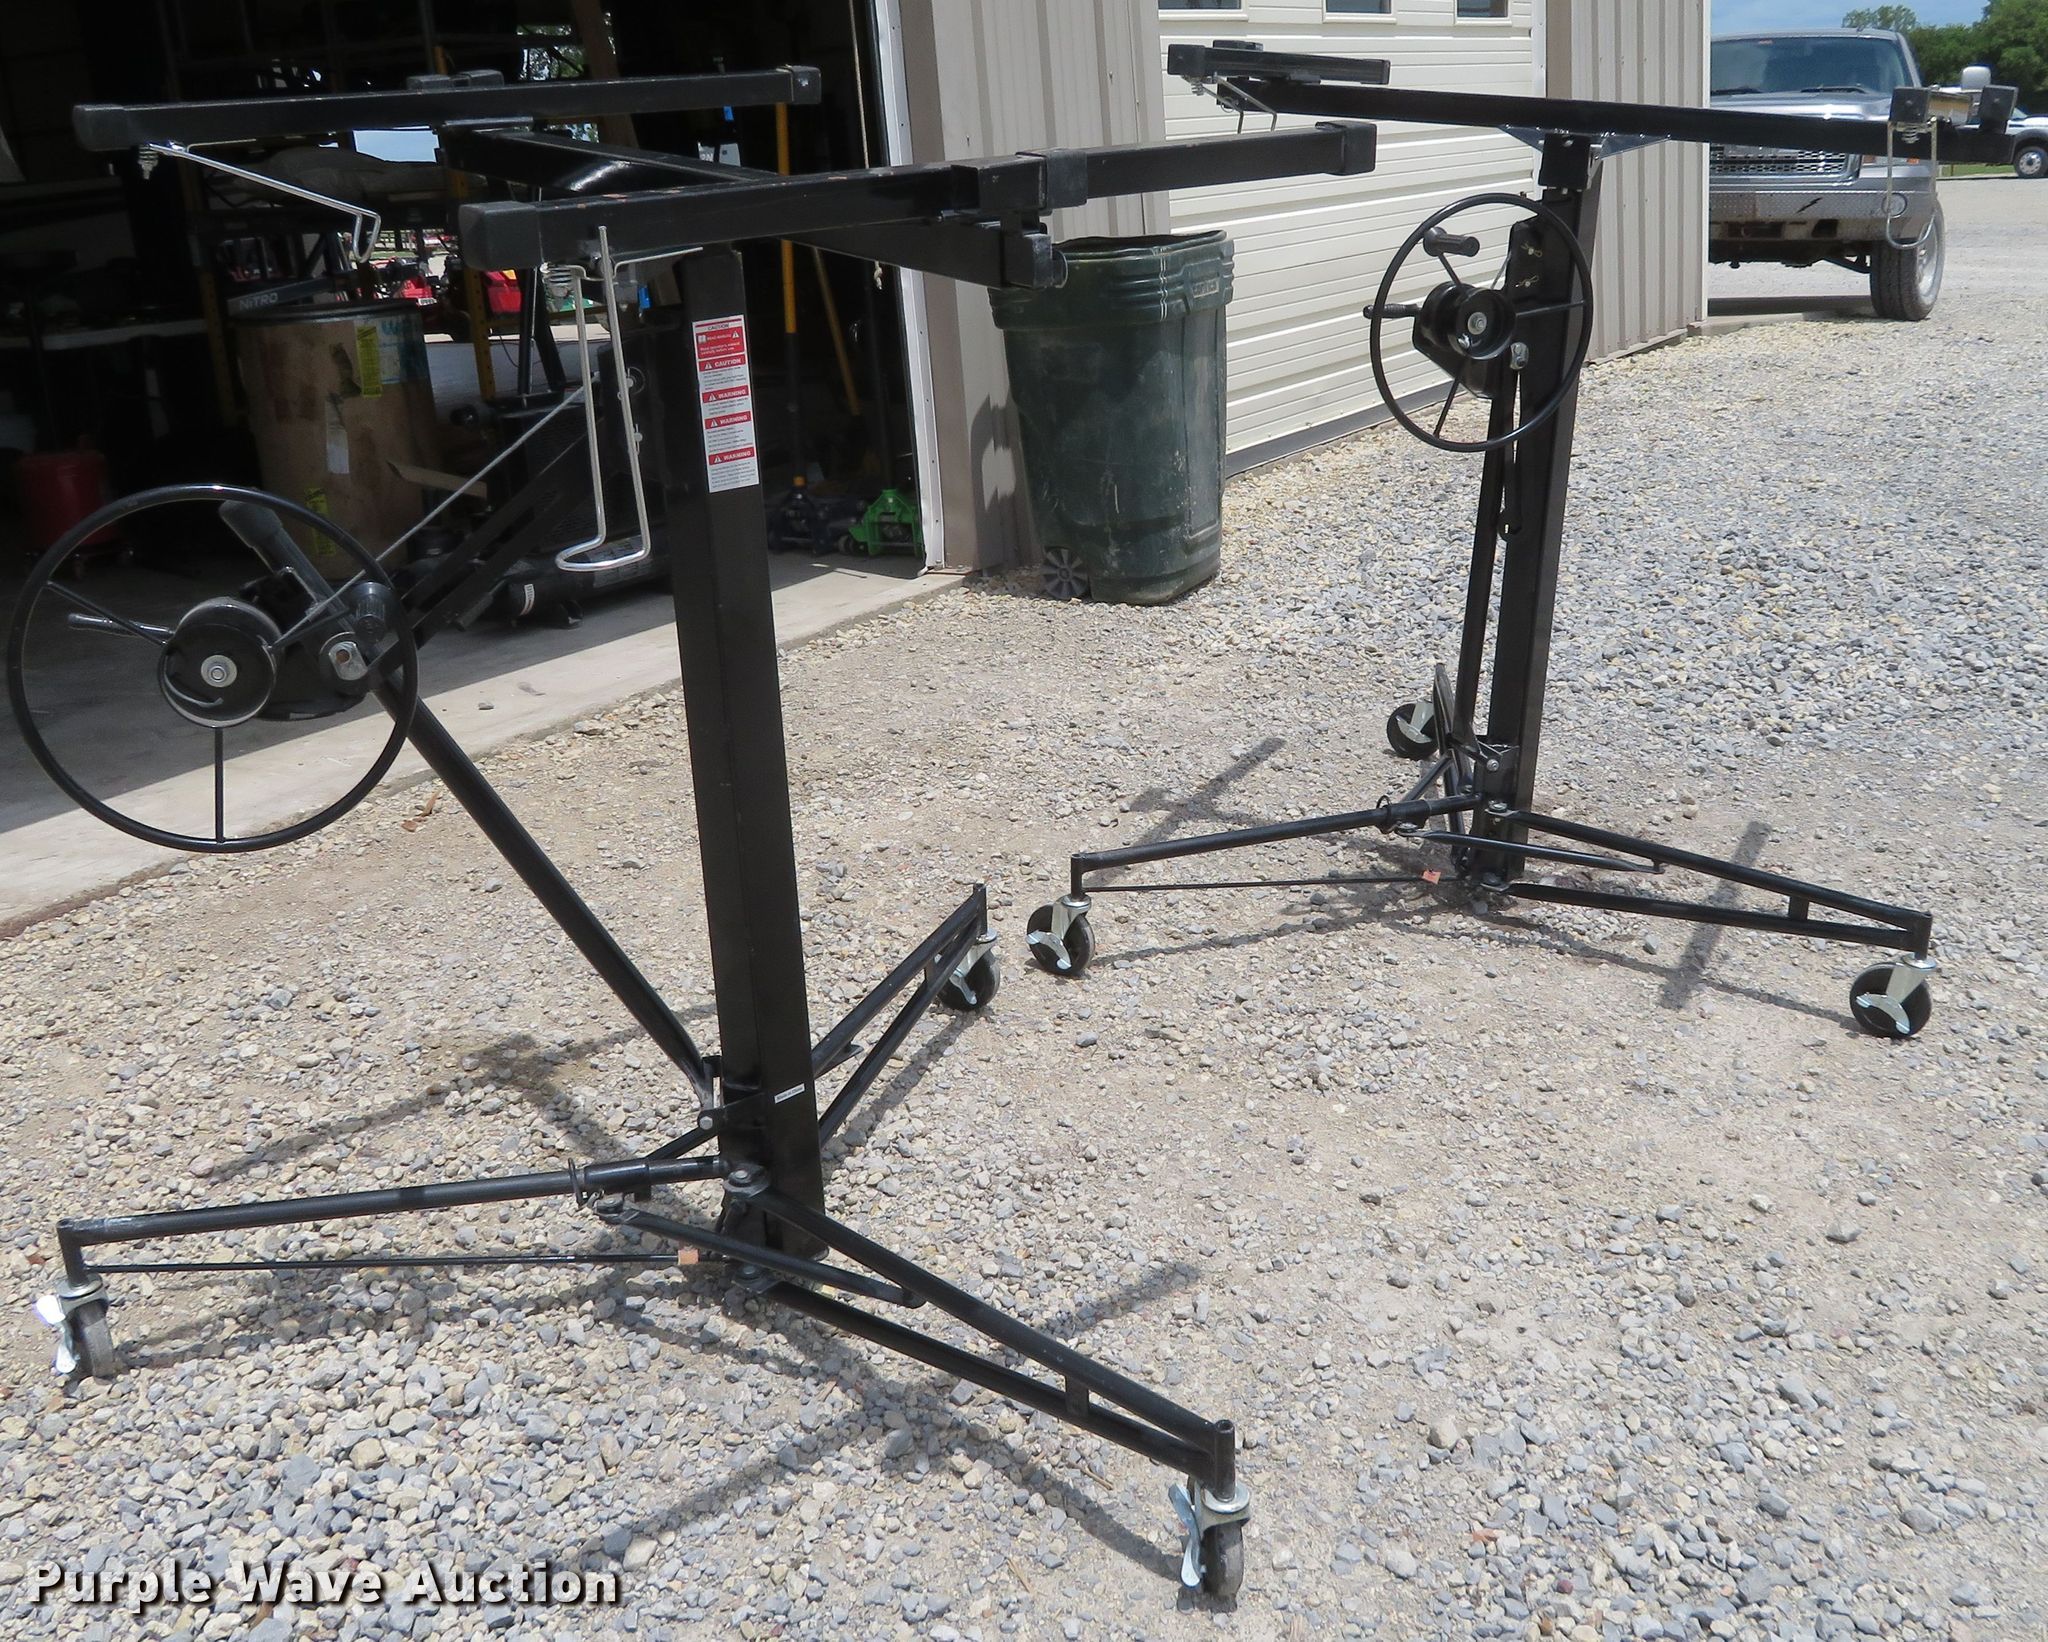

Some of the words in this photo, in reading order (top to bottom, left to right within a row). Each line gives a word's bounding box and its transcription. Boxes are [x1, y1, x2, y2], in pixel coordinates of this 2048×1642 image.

[714, 358, 742, 367] CAUTION
[718, 389, 746, 399] WARNING
[720, 415, 748, 424] WARNING
[723, 450, 751, 460] WARNING
